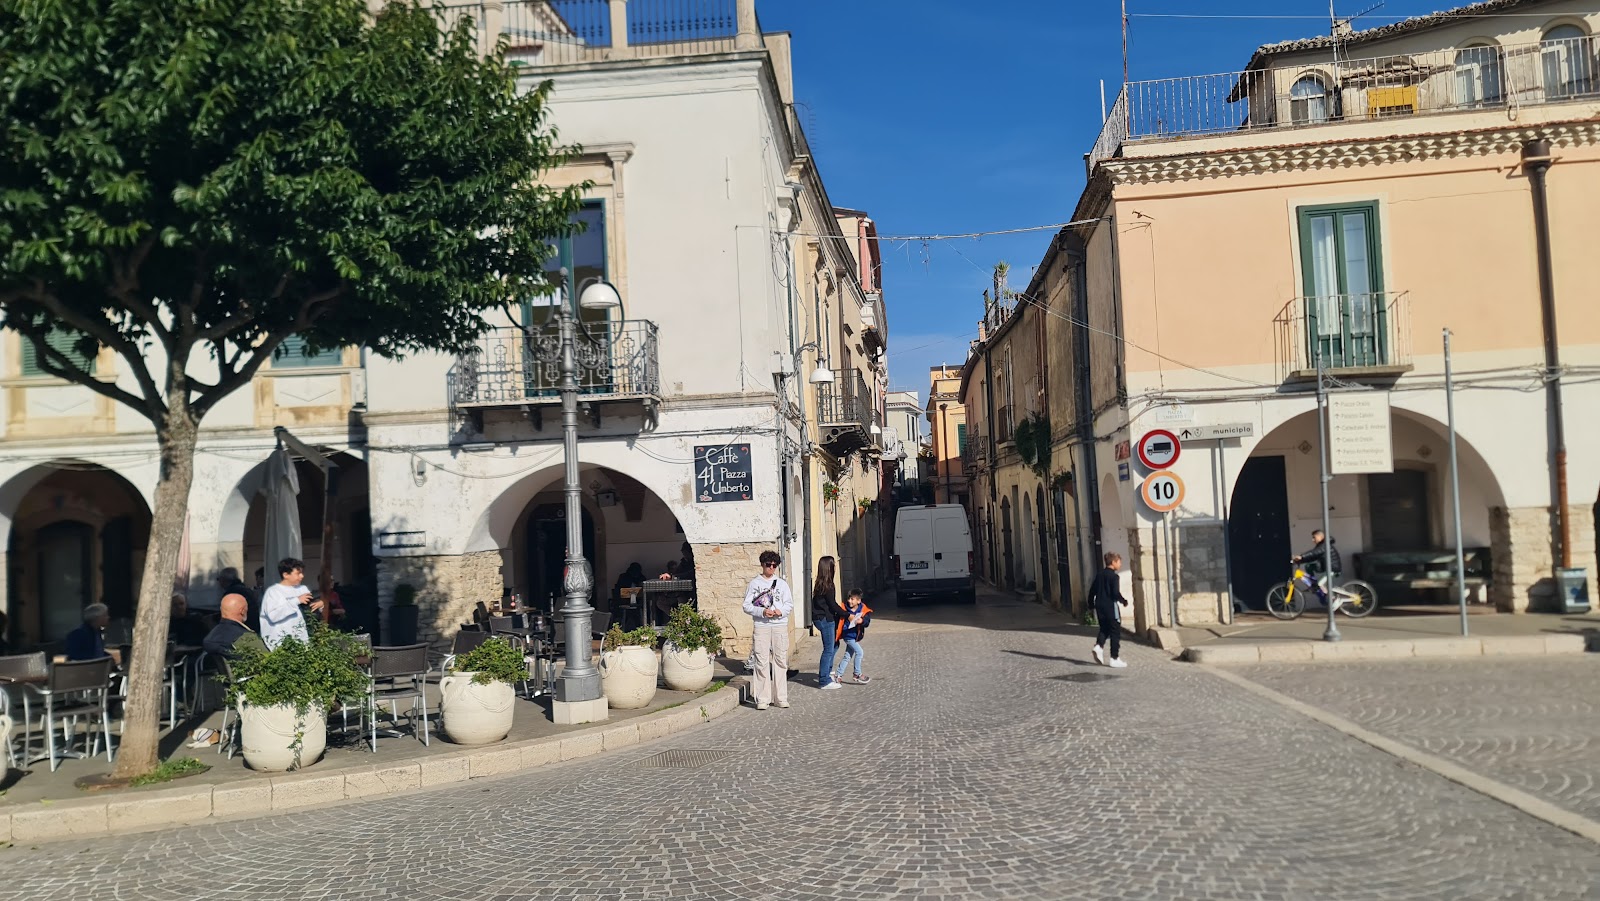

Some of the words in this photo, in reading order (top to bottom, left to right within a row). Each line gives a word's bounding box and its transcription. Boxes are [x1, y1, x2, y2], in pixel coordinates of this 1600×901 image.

[1212, 426, 1250, 435] municipio
[706, 446, 738, 466] Caffè
[698, 464, 714, 488] 41
[720, 466, 746, 482] Piazza
[712, 482, 750, 494] Umberto
[1153, 482, 1174, 500] 10
